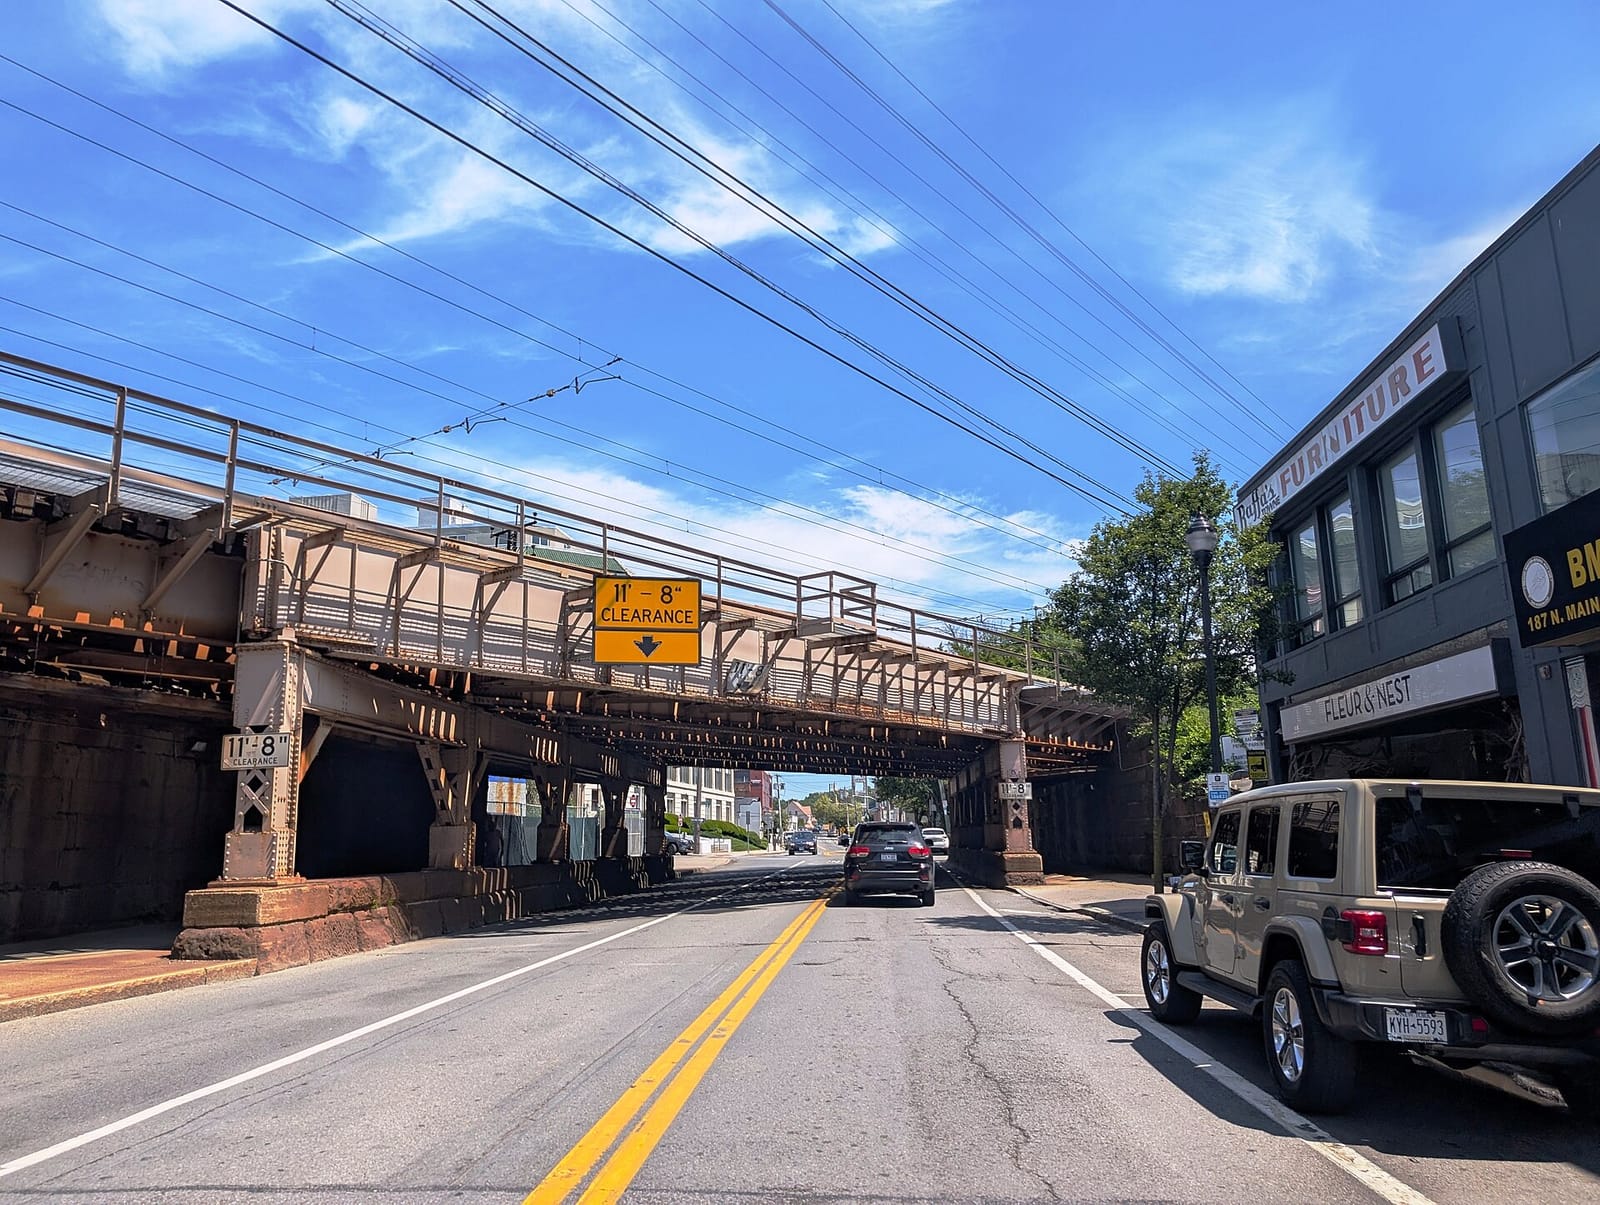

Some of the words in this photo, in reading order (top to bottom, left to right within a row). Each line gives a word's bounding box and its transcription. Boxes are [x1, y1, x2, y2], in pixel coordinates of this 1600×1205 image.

[1279, 341, 1436, 498] FURNITURE
[601, 607, 694, 624] CLEARANCE
[1528, 612, 1547, 632] 187
[1550, 609, 1564, 626] N.
[1565, 596, 1600, 621] MAIN
[1324, 691, 1362, 722] FLEUR
[1364, 684, 1375, 714] &
[1376, 675, 1410, 709] NEST
[233, 757, 278, 766] CLEARANCE
